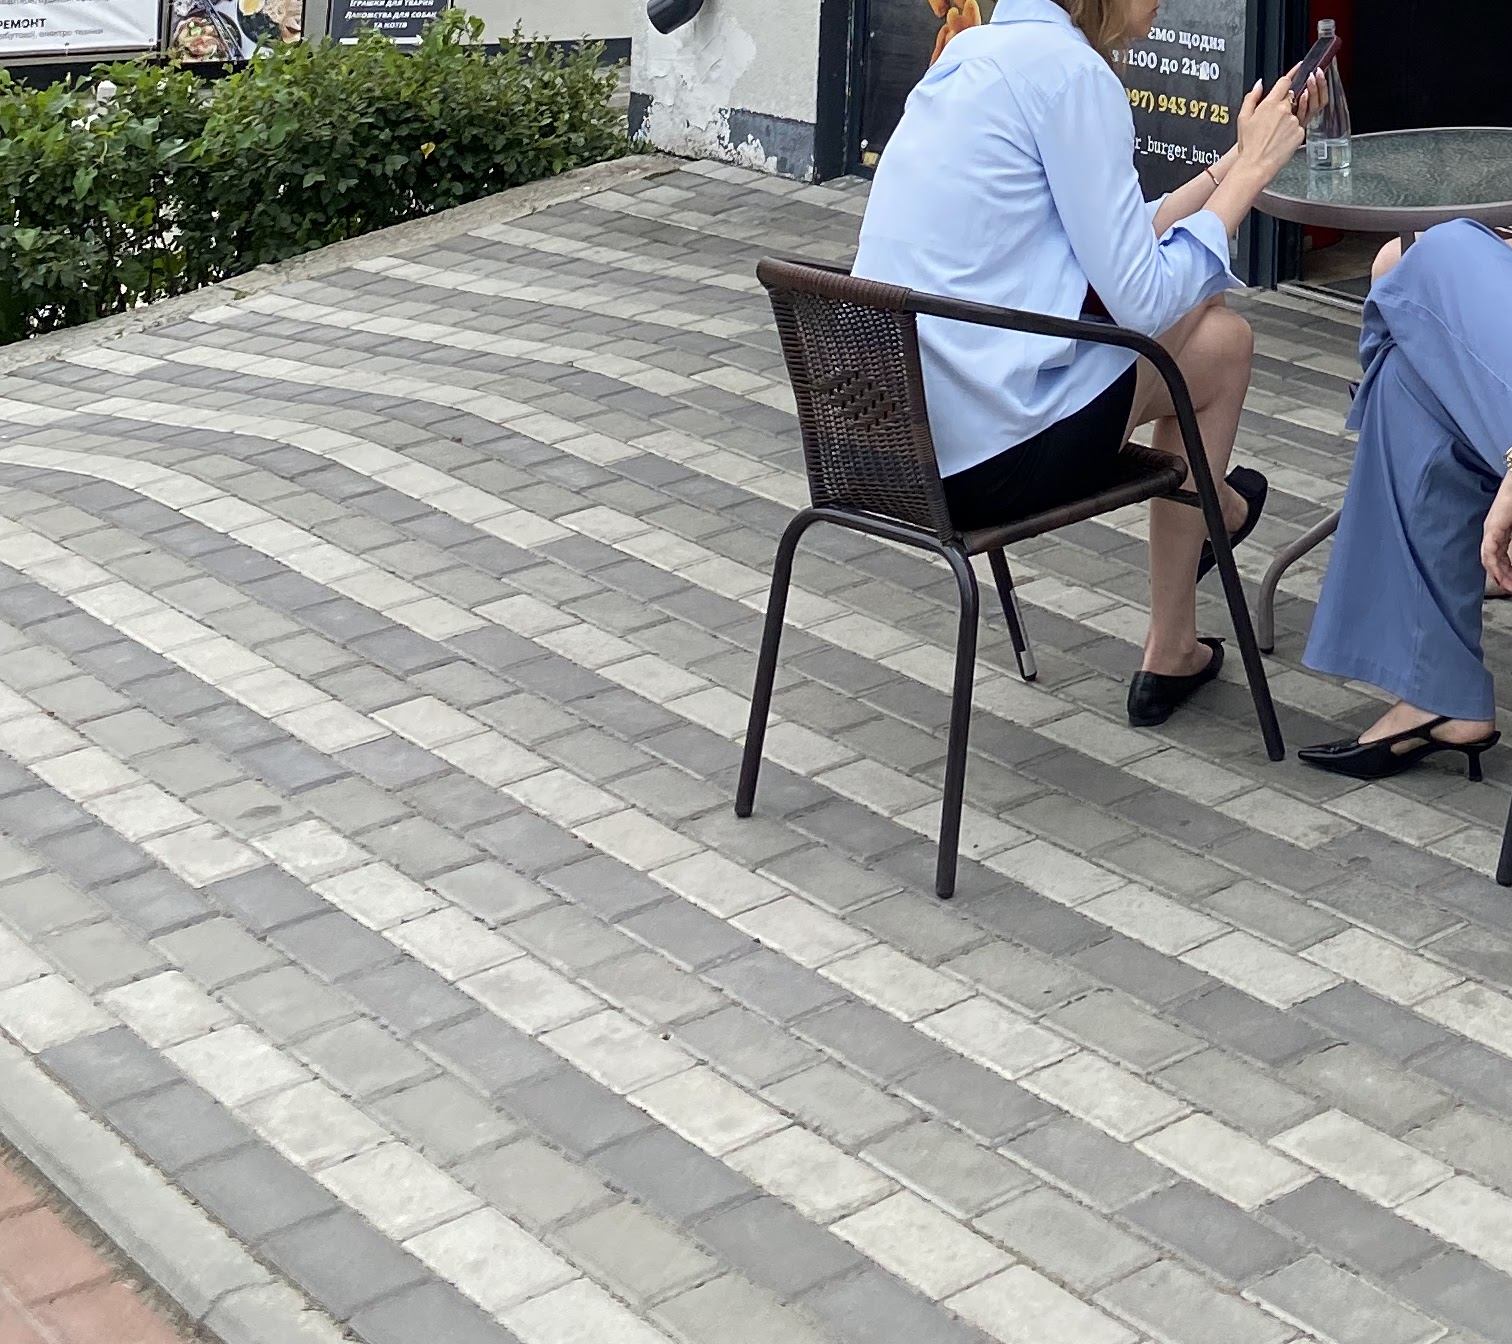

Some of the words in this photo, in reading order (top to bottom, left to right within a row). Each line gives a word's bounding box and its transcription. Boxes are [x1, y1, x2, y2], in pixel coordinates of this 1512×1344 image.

[1178, 31, 1226, 52] щодня
[1160, 58, 1179, 75] до
[1158, 94, 1187, 116] 943
[1190, 99, 1208, 120] 97
[1210, 104, 1230, 125] 25
